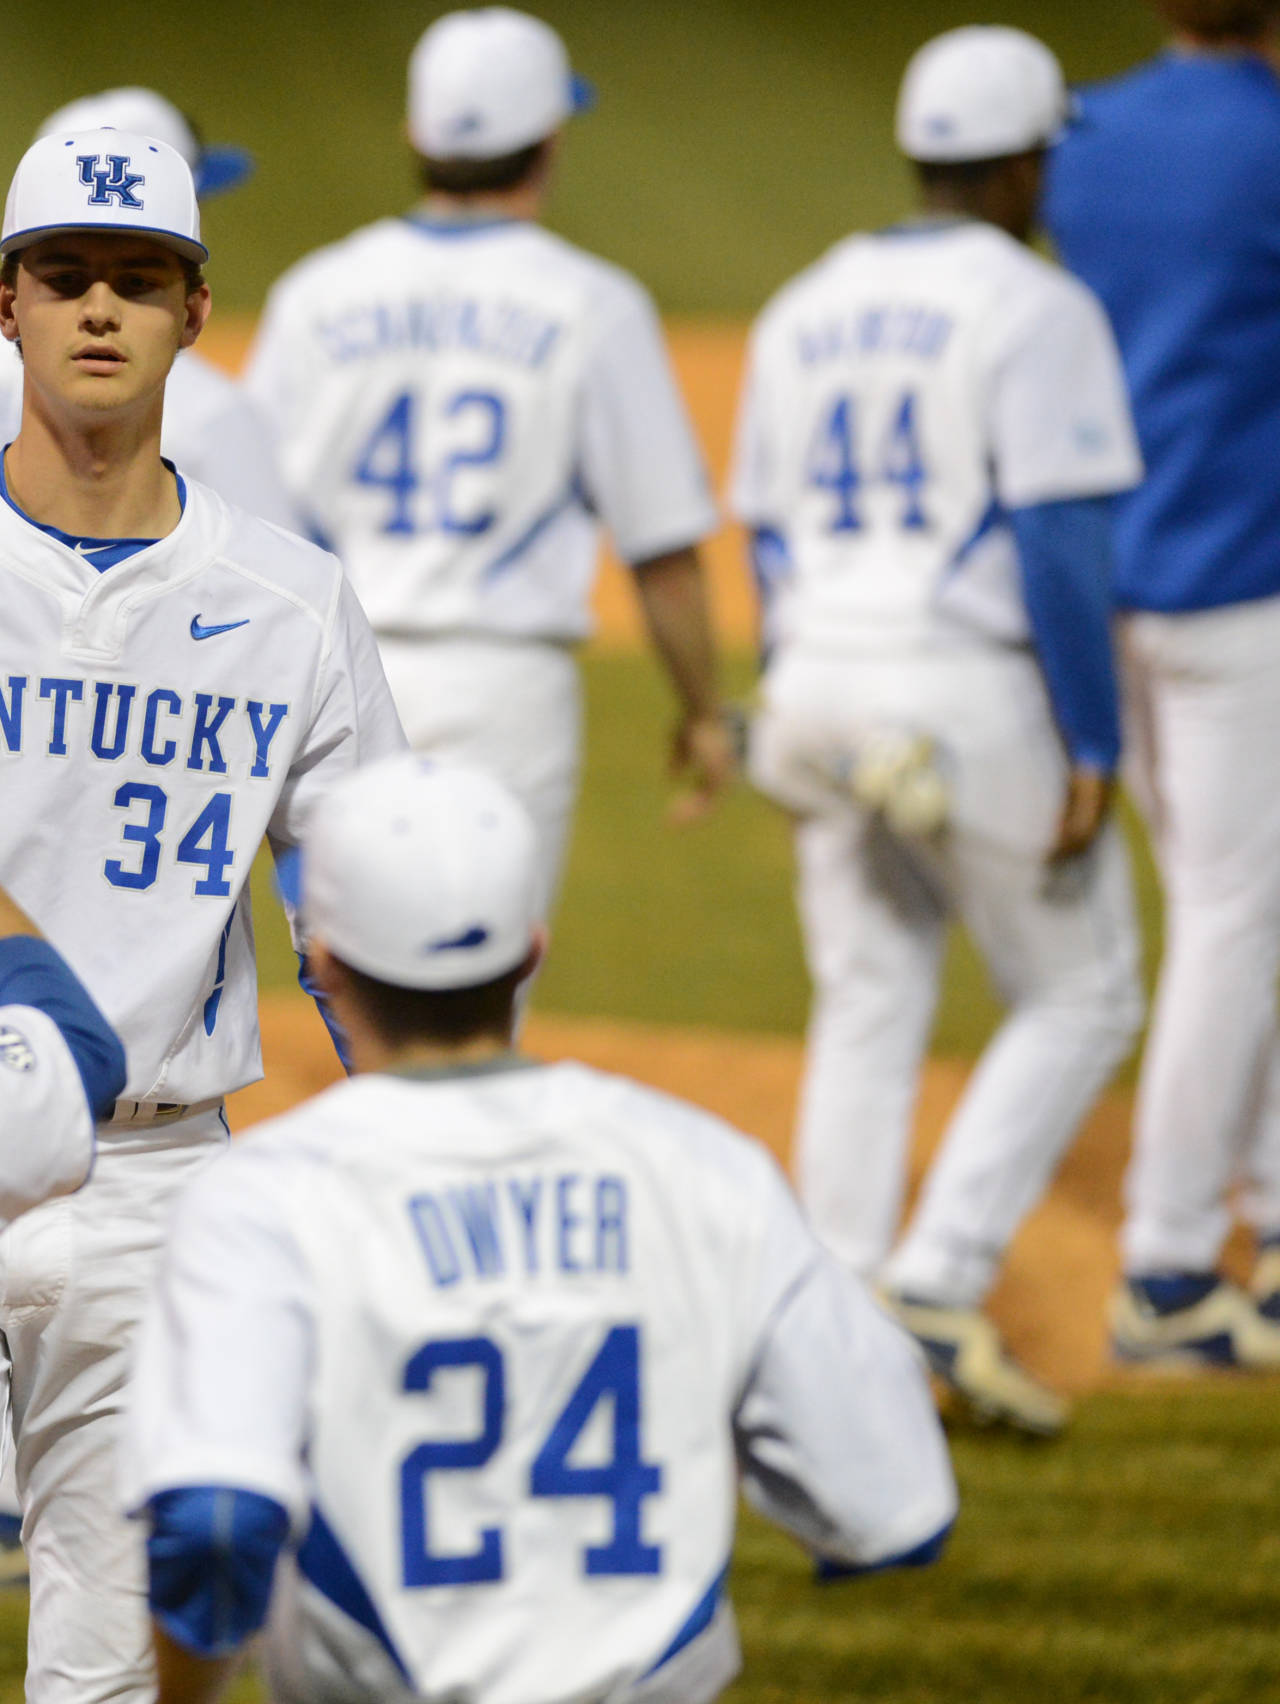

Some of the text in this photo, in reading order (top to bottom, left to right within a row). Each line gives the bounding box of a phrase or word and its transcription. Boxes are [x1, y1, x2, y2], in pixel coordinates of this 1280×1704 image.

[76, 154, 145, 209] UK
[352, 390, 505, 536] 42
[811, 395, 927, 534] 44
[104, 782, 235, 897] 34
[408, 1174, 629, 1288] DWYER
[399, 1323, 663, 1589] 24
